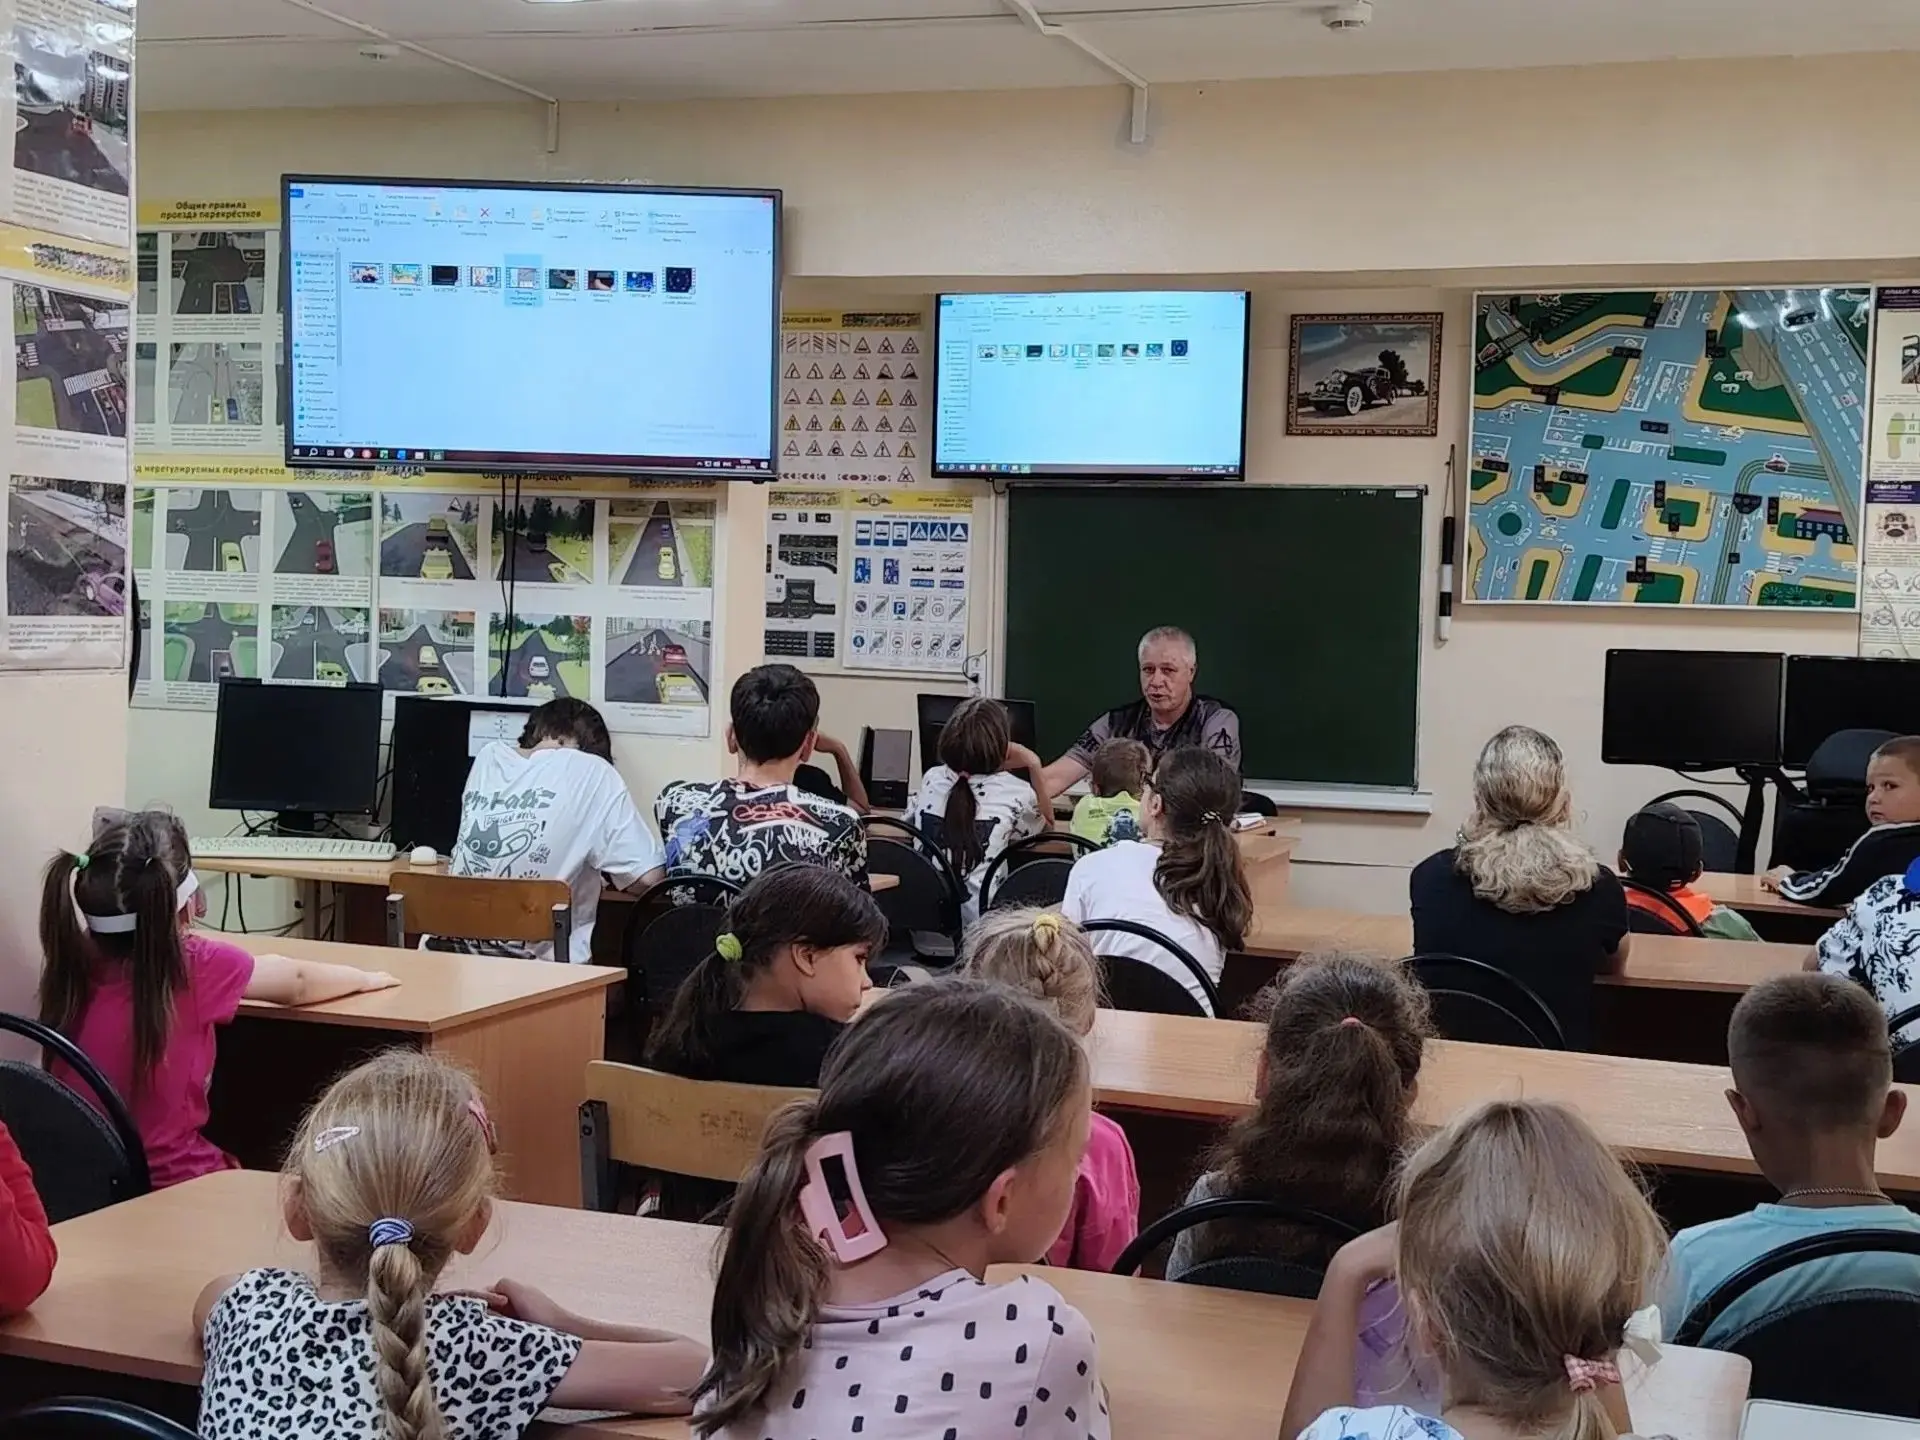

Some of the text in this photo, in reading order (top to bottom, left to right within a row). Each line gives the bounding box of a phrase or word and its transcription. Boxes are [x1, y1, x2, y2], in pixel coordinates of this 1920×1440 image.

[176, 201, 247, 210] Общие правила
[160, 211, 197, 220] проезда
